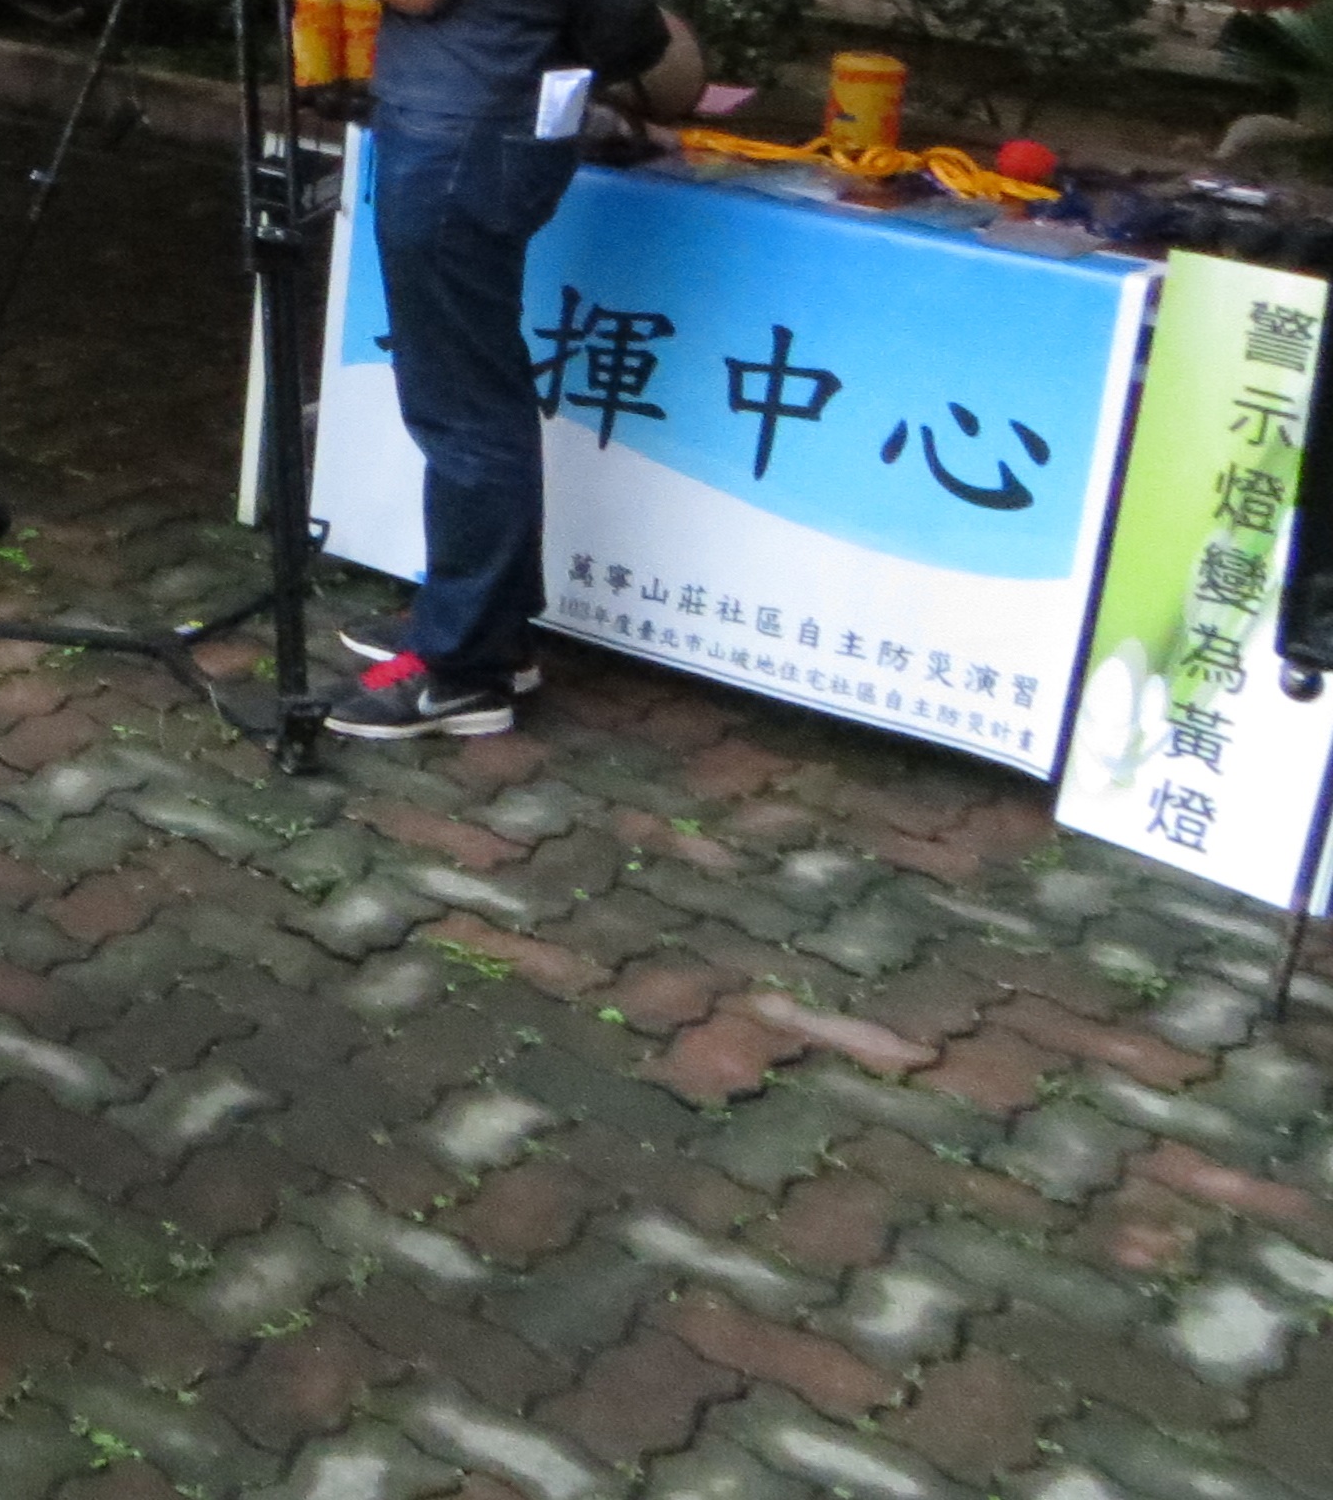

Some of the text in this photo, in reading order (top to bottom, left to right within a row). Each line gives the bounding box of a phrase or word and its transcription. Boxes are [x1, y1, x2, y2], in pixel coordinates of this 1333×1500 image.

[374, 284, 1051, 512] 揮中心
[1146, 299, 1319, 854] 警示燈變為黃燈
